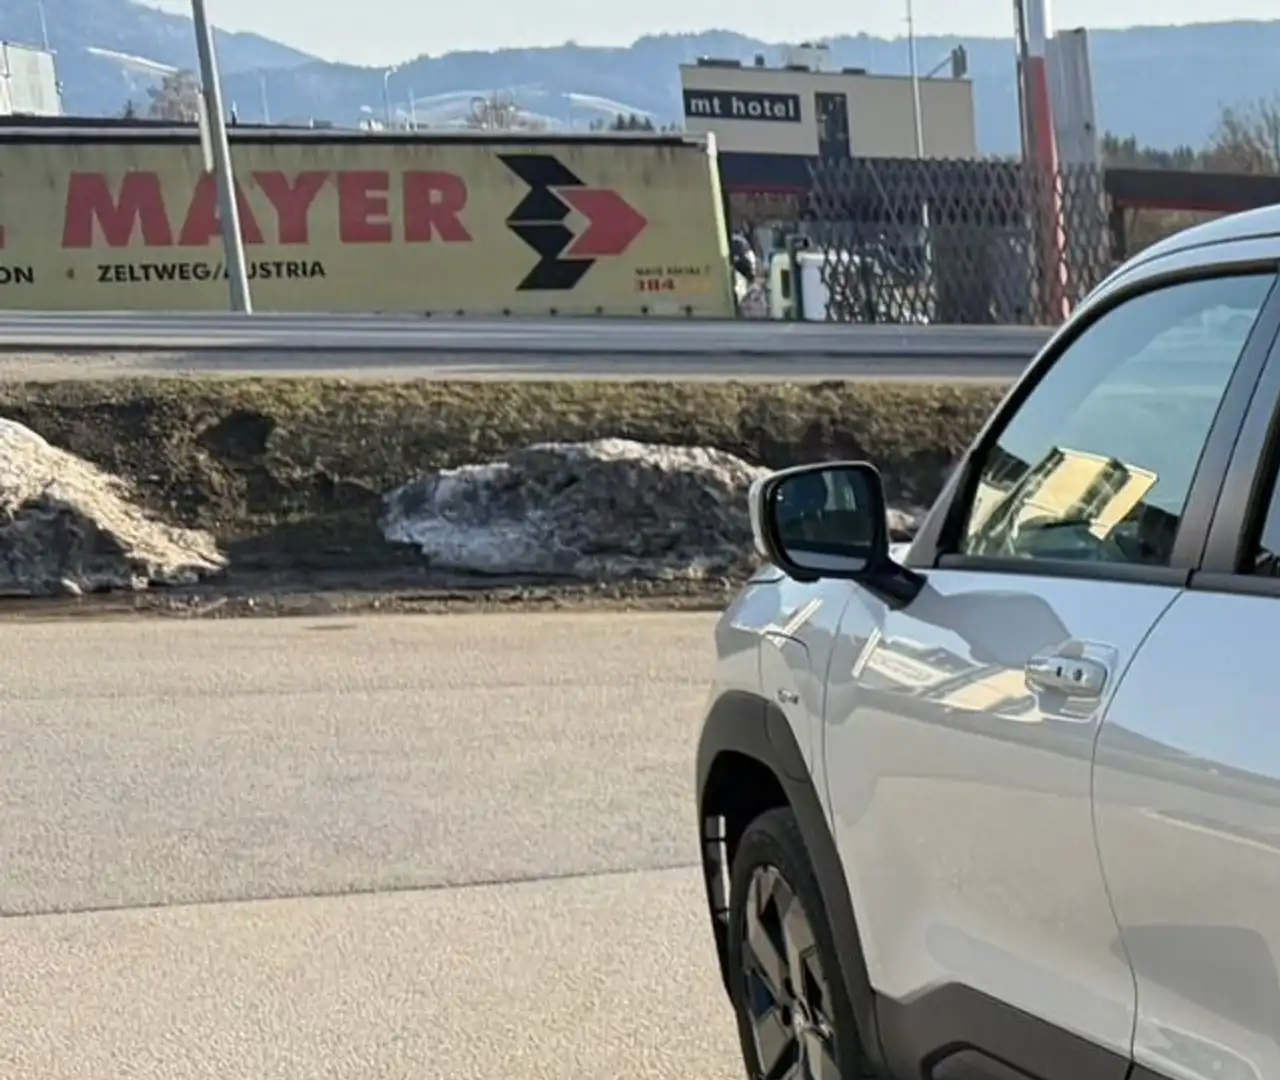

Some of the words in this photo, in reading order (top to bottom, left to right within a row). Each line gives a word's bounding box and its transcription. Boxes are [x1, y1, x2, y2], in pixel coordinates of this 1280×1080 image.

[690, 97, 721, 114] mt
[731, 95, 796, 118] hotel
[62, 171, 473, 248] MAYER
[97, 261, 326, 284] ZELTWEG/USTRIA
